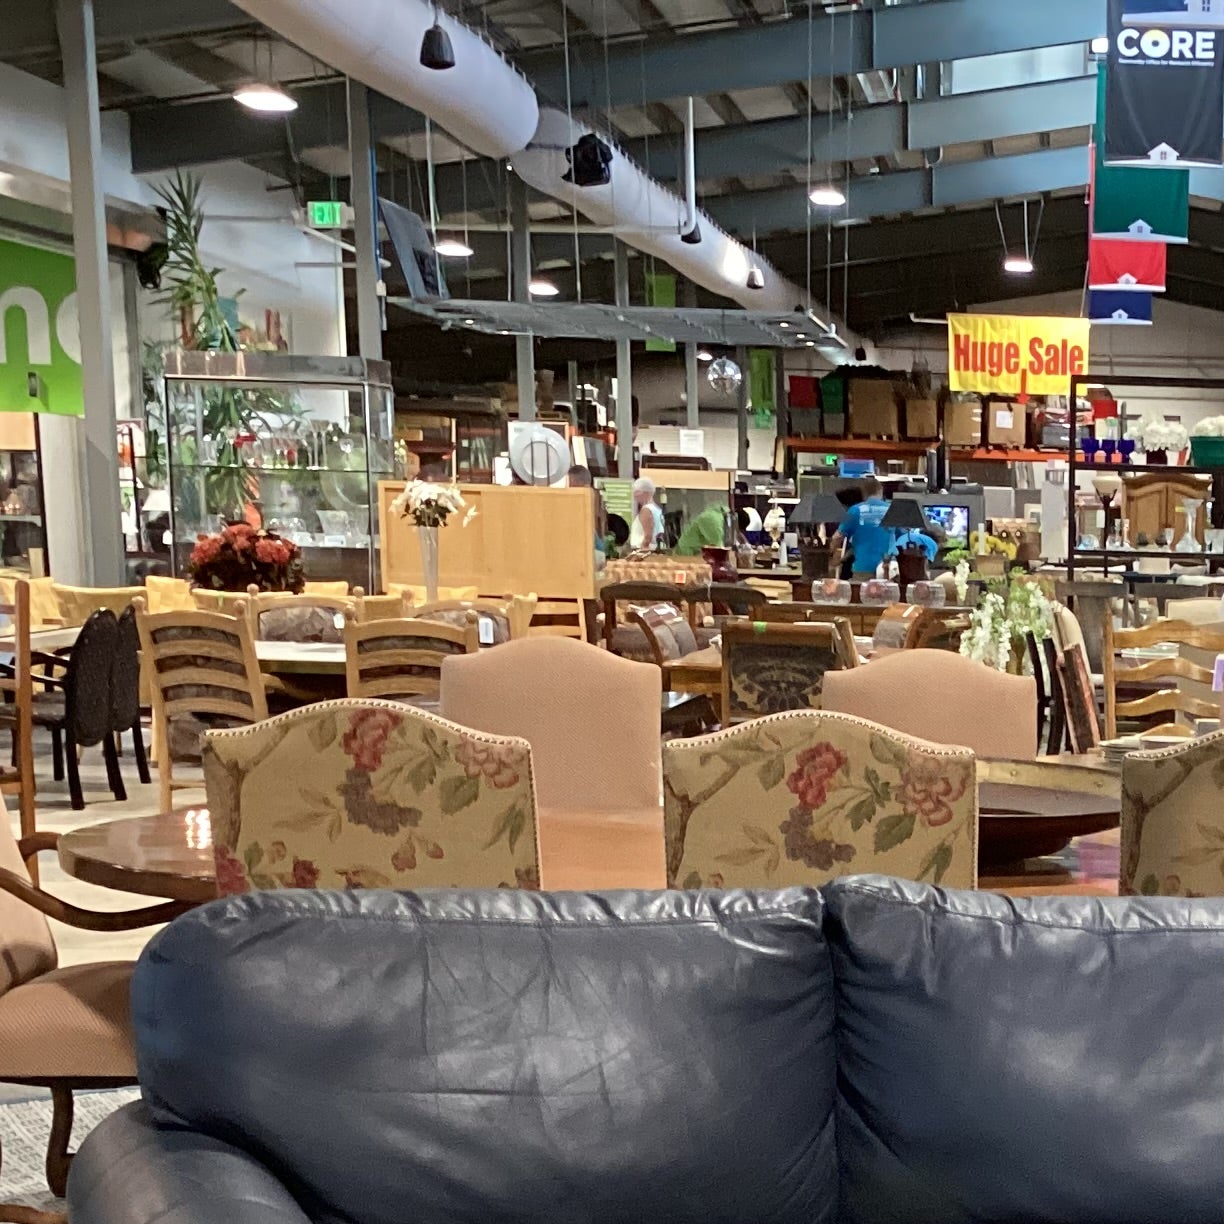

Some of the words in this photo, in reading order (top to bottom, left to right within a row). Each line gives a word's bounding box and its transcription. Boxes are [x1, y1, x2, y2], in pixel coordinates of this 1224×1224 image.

[1117, 28, 1216, 59] CORE
[314, 202, 341, 225] EXIT
[953, 333, 1020, 377] Huge
[1028, 336, 1084, 376] Sale
